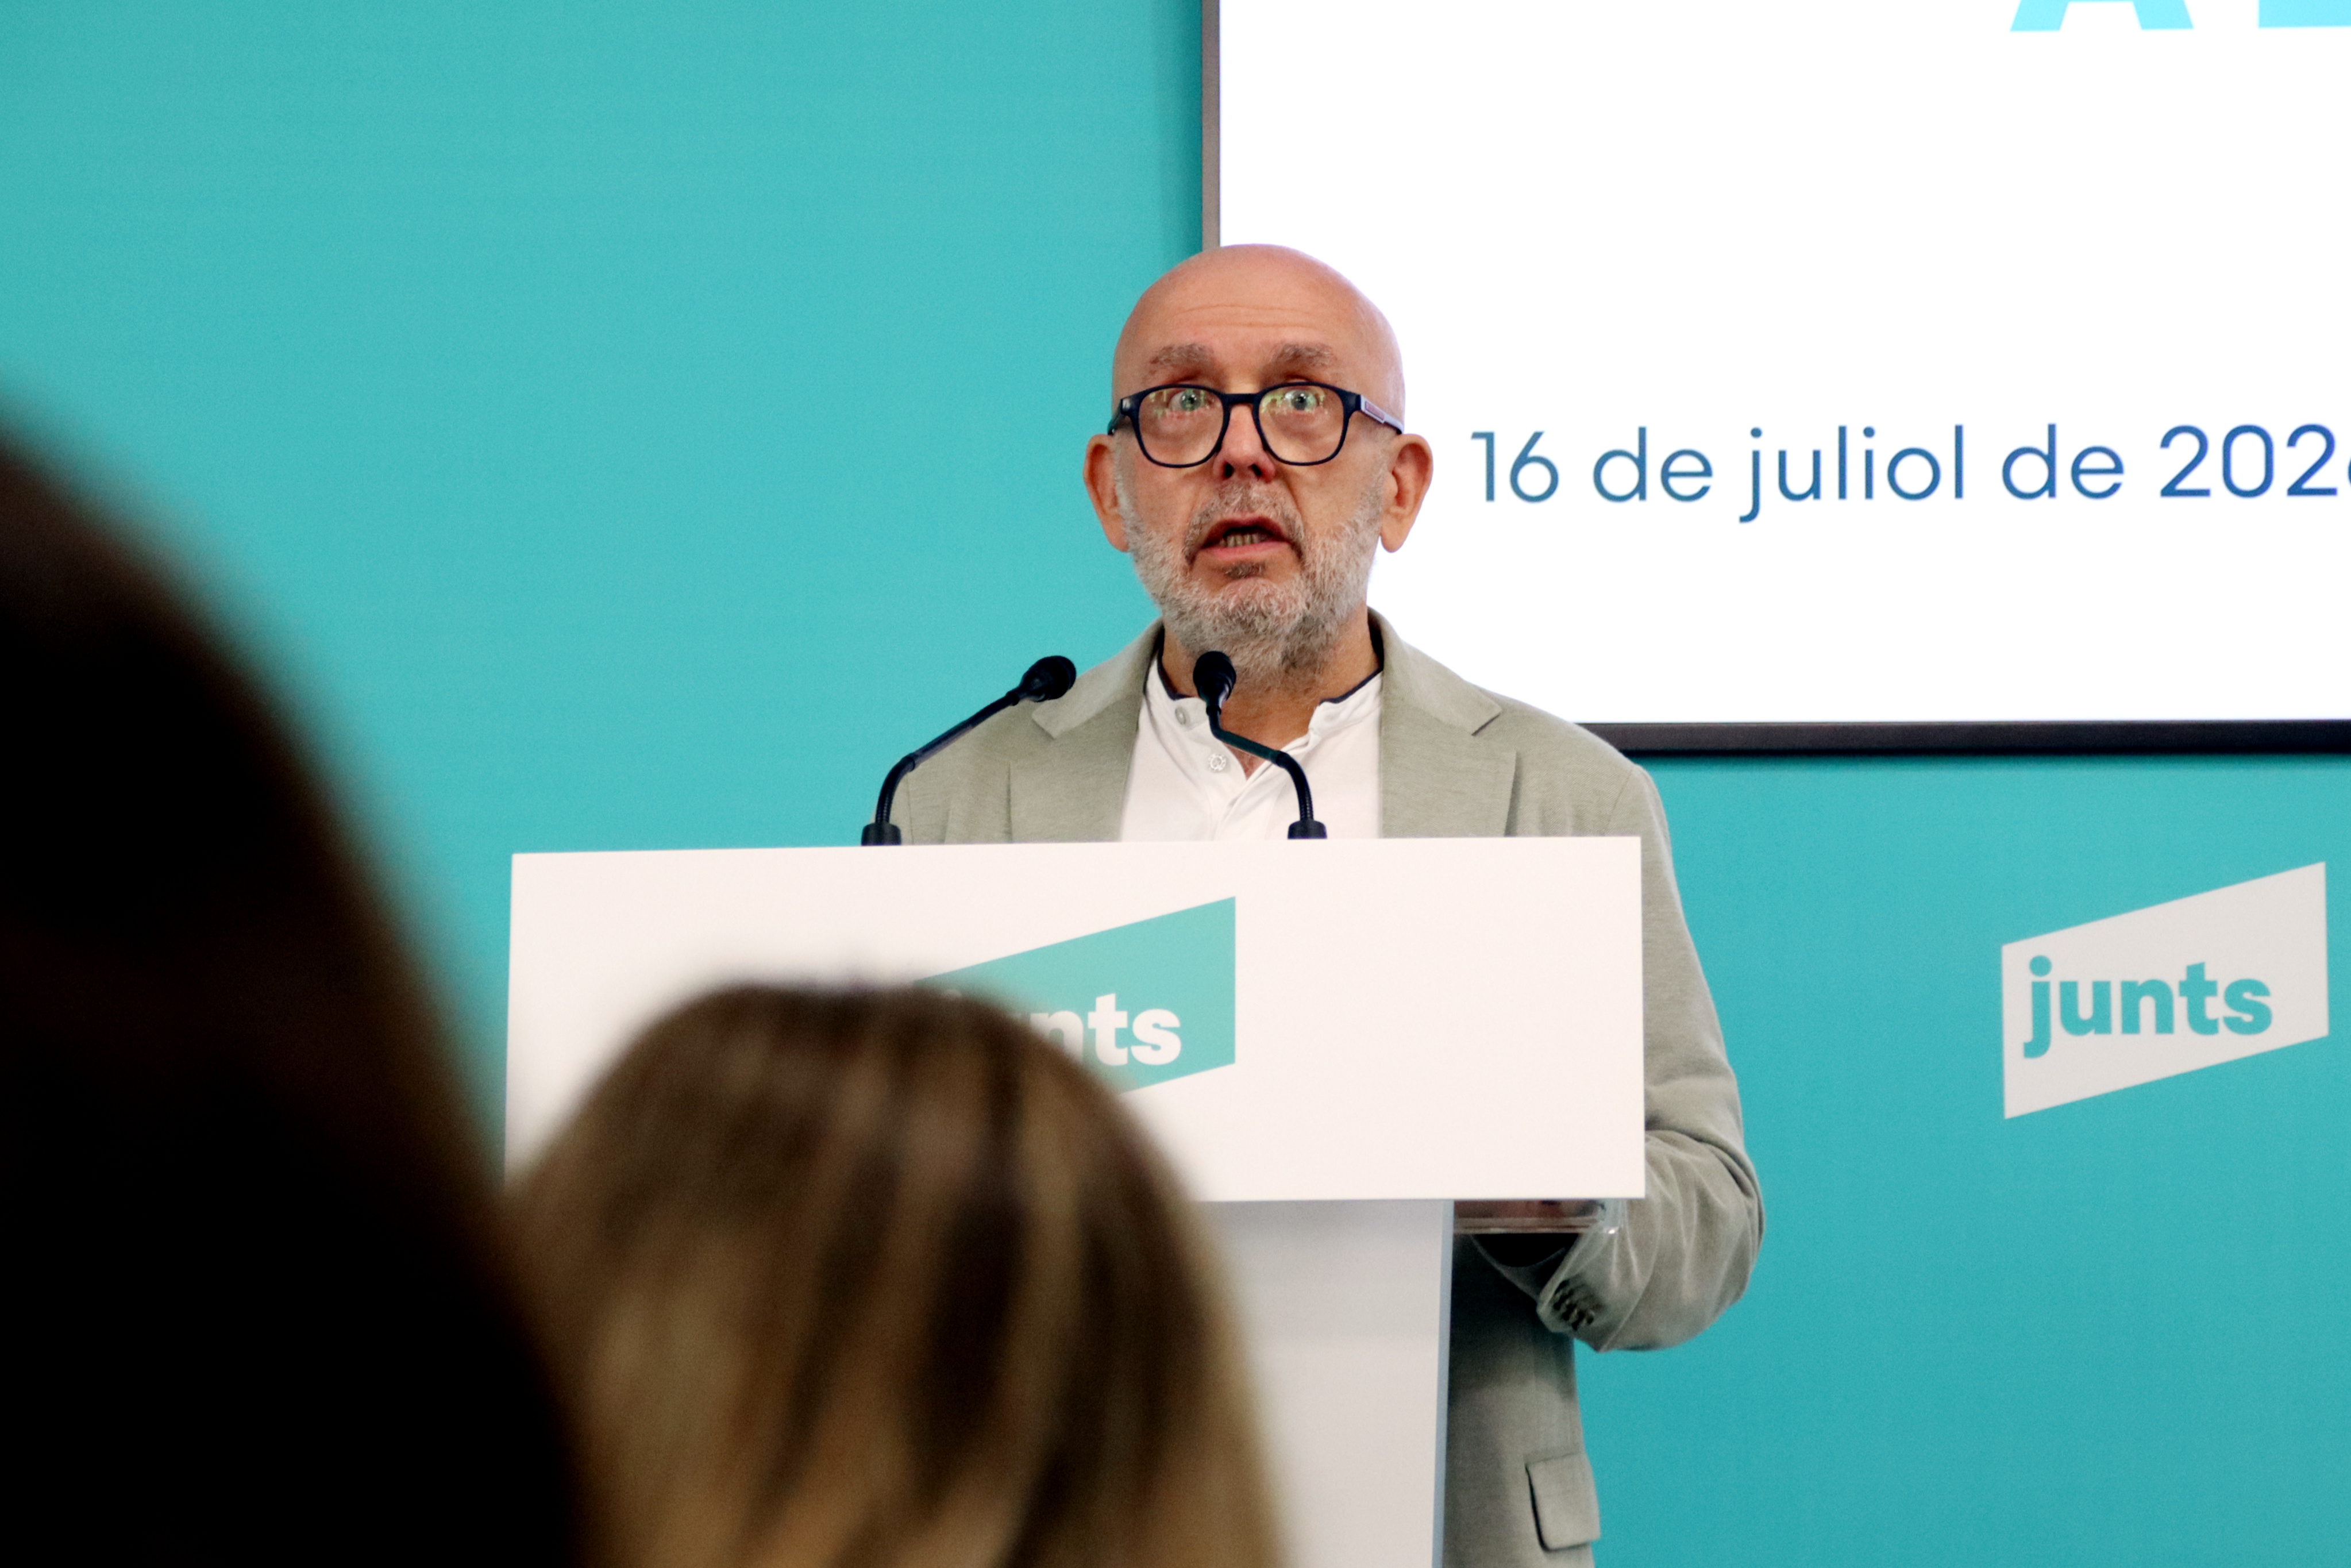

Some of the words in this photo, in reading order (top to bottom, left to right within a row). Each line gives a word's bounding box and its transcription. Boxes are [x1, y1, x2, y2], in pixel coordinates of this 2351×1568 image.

[1471, 432, 1559, 503] 16
[1593, 426, 1713, 503] de
[1739, 424, 1964, 523] juliol
[2002, 423, 2125, 500] de
[2160, 423, 2351, 499] 202
[941, 990, 1182, 1066] nts
[2023, 955, 2273, 1059] junts
